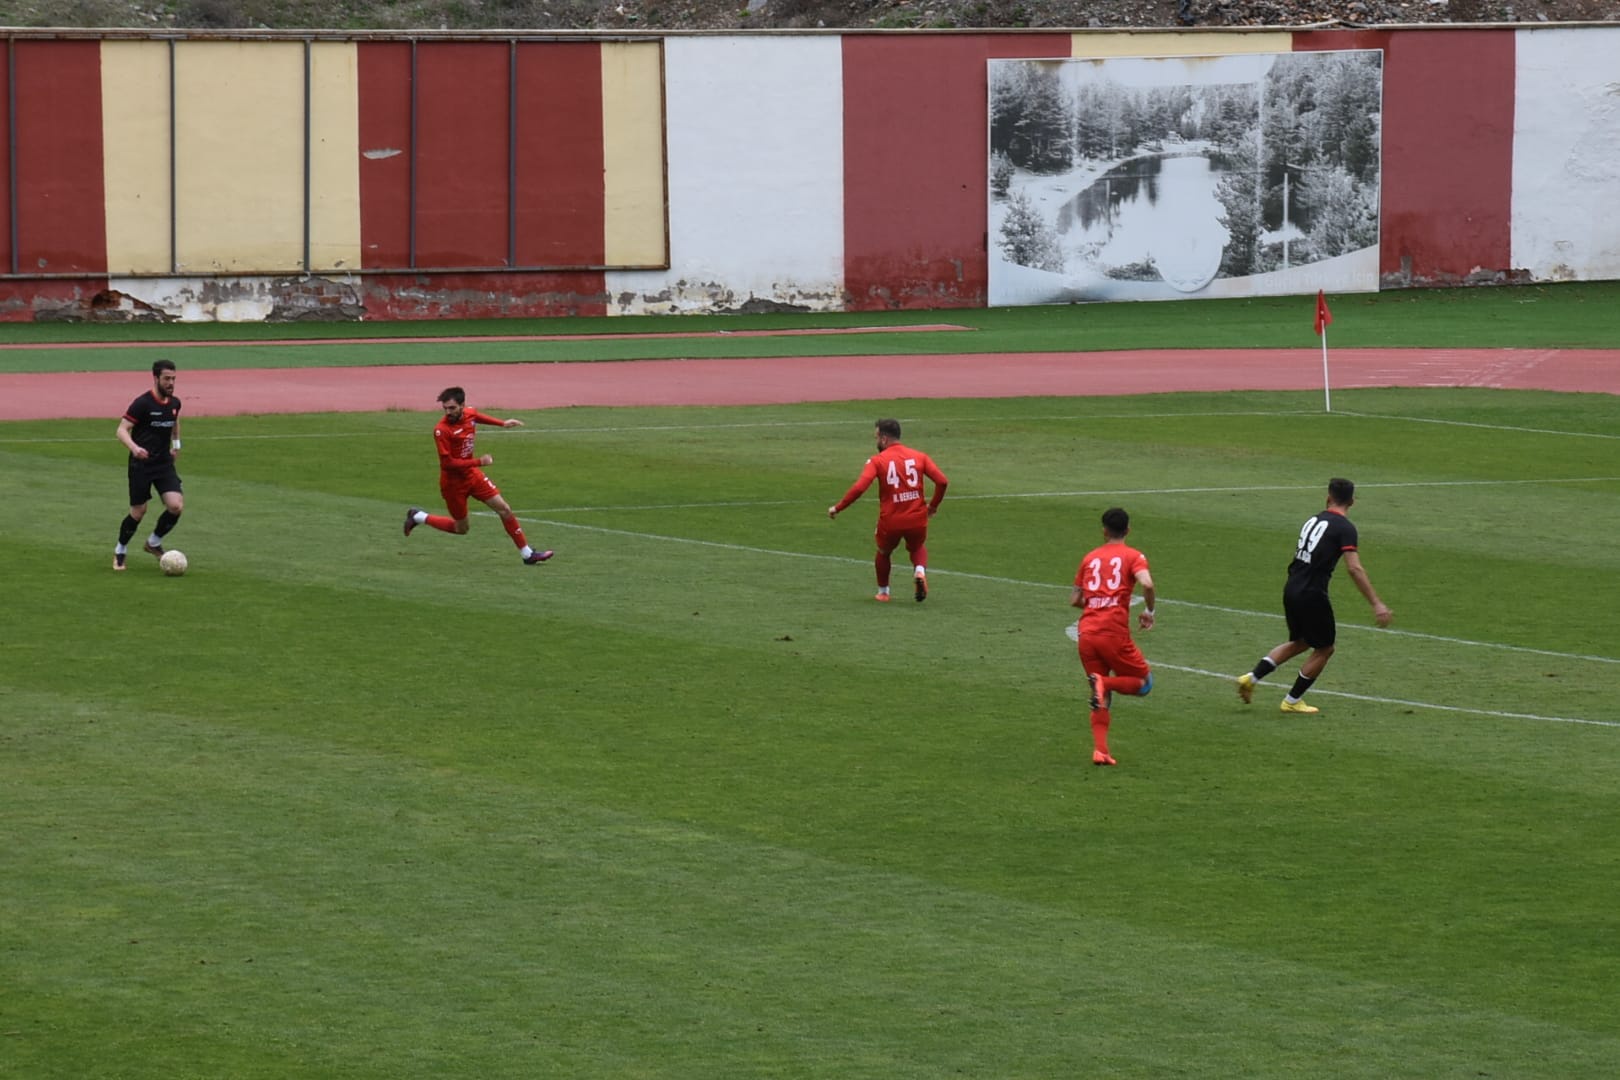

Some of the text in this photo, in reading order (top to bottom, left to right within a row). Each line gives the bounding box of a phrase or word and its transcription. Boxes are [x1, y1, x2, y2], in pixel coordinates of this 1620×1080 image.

[886, 458, 918, 489] 45
[1298, 516, 1329, 553] 99
[1088, 556, 1122, 591] 33
